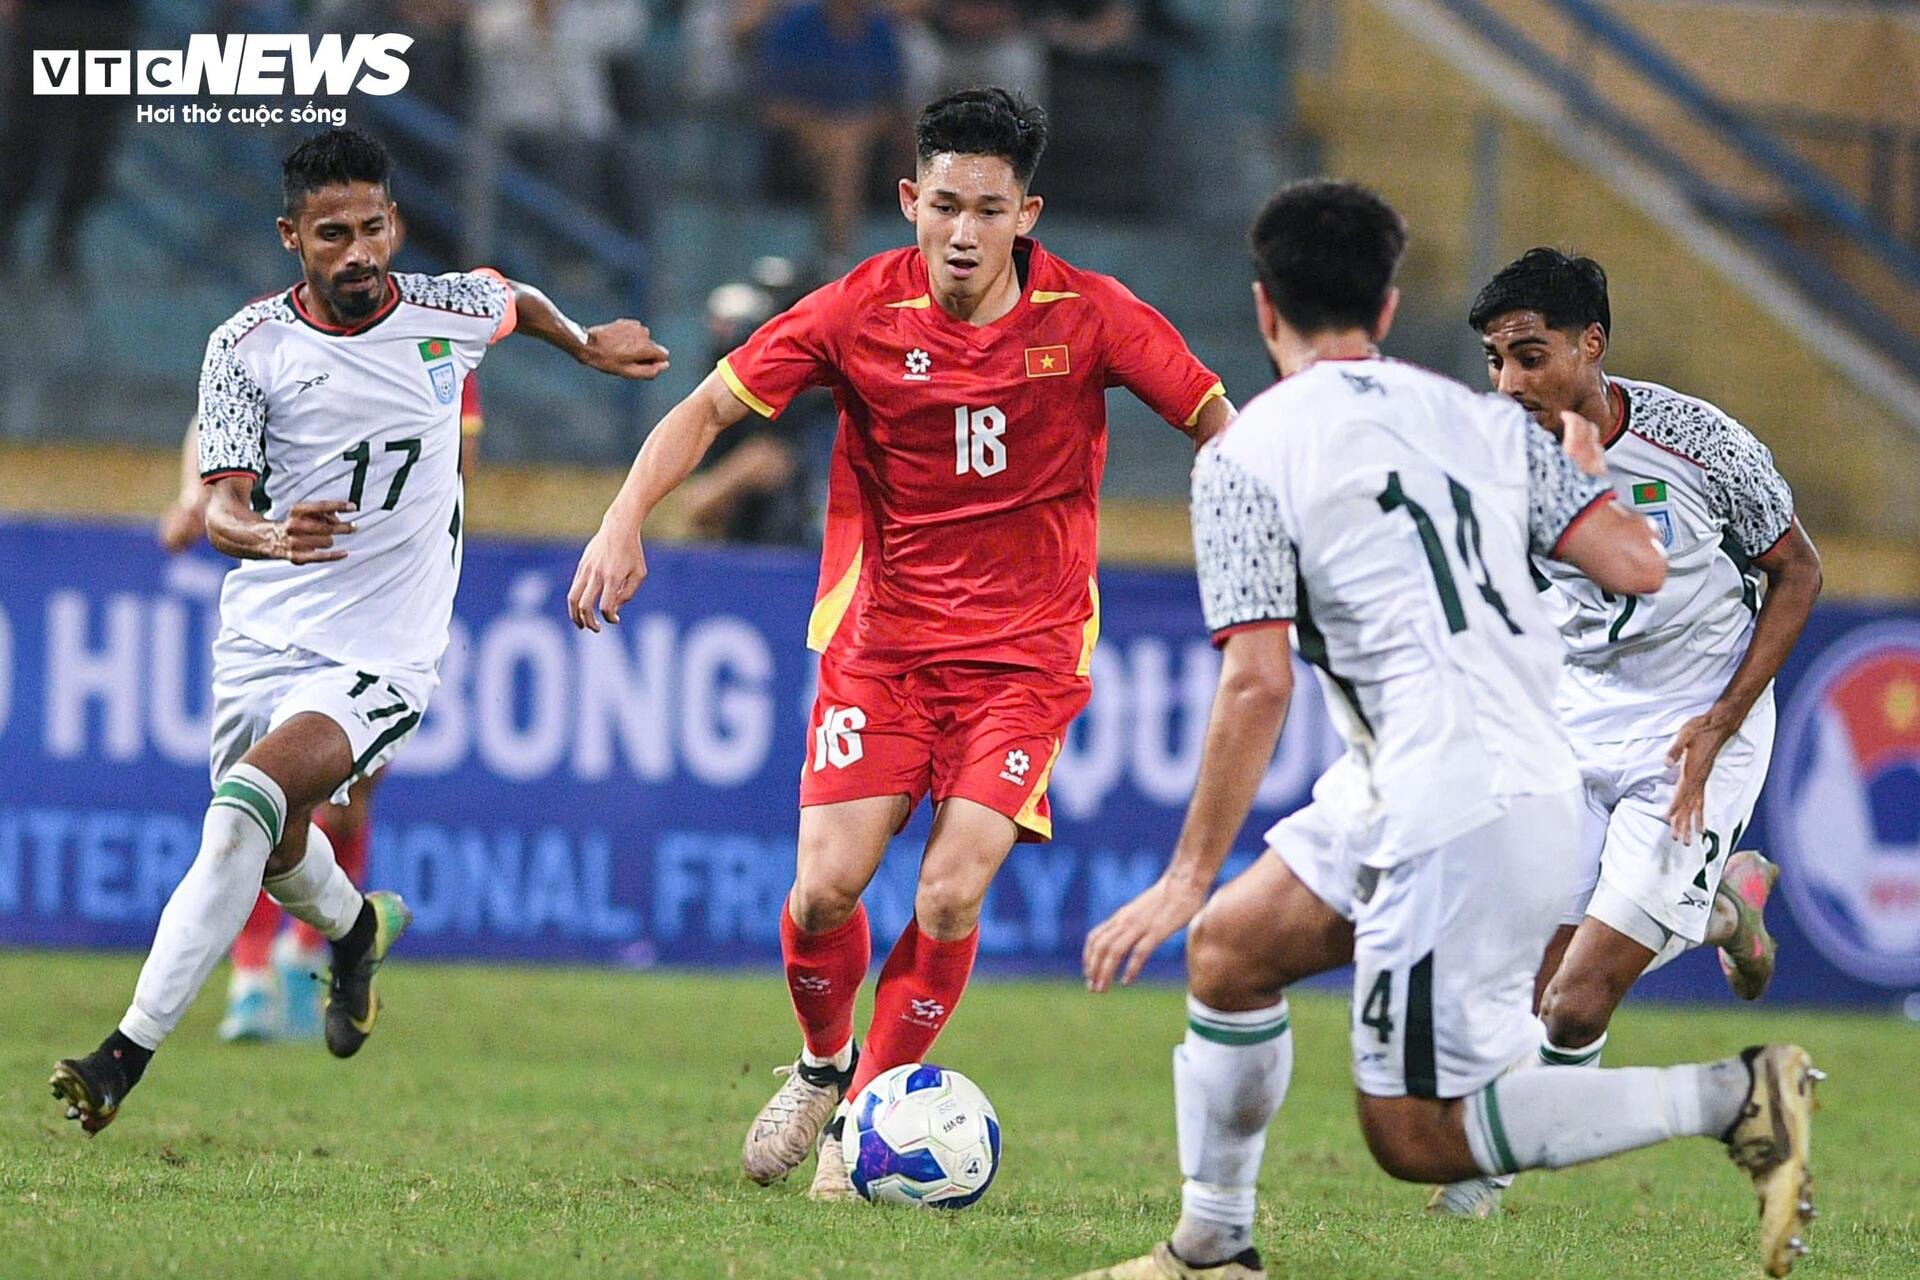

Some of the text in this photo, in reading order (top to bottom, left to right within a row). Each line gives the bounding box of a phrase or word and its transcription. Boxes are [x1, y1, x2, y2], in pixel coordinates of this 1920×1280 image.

[343, 438, 421, 511] 17
[955, 405, 1007, 478] 18
[1376, 470, 1525, 635] 14
[346, 669, 409, 722] 17
[813, 705, 867, 773] 18
[1362, 969, 1394, 1044] 4
